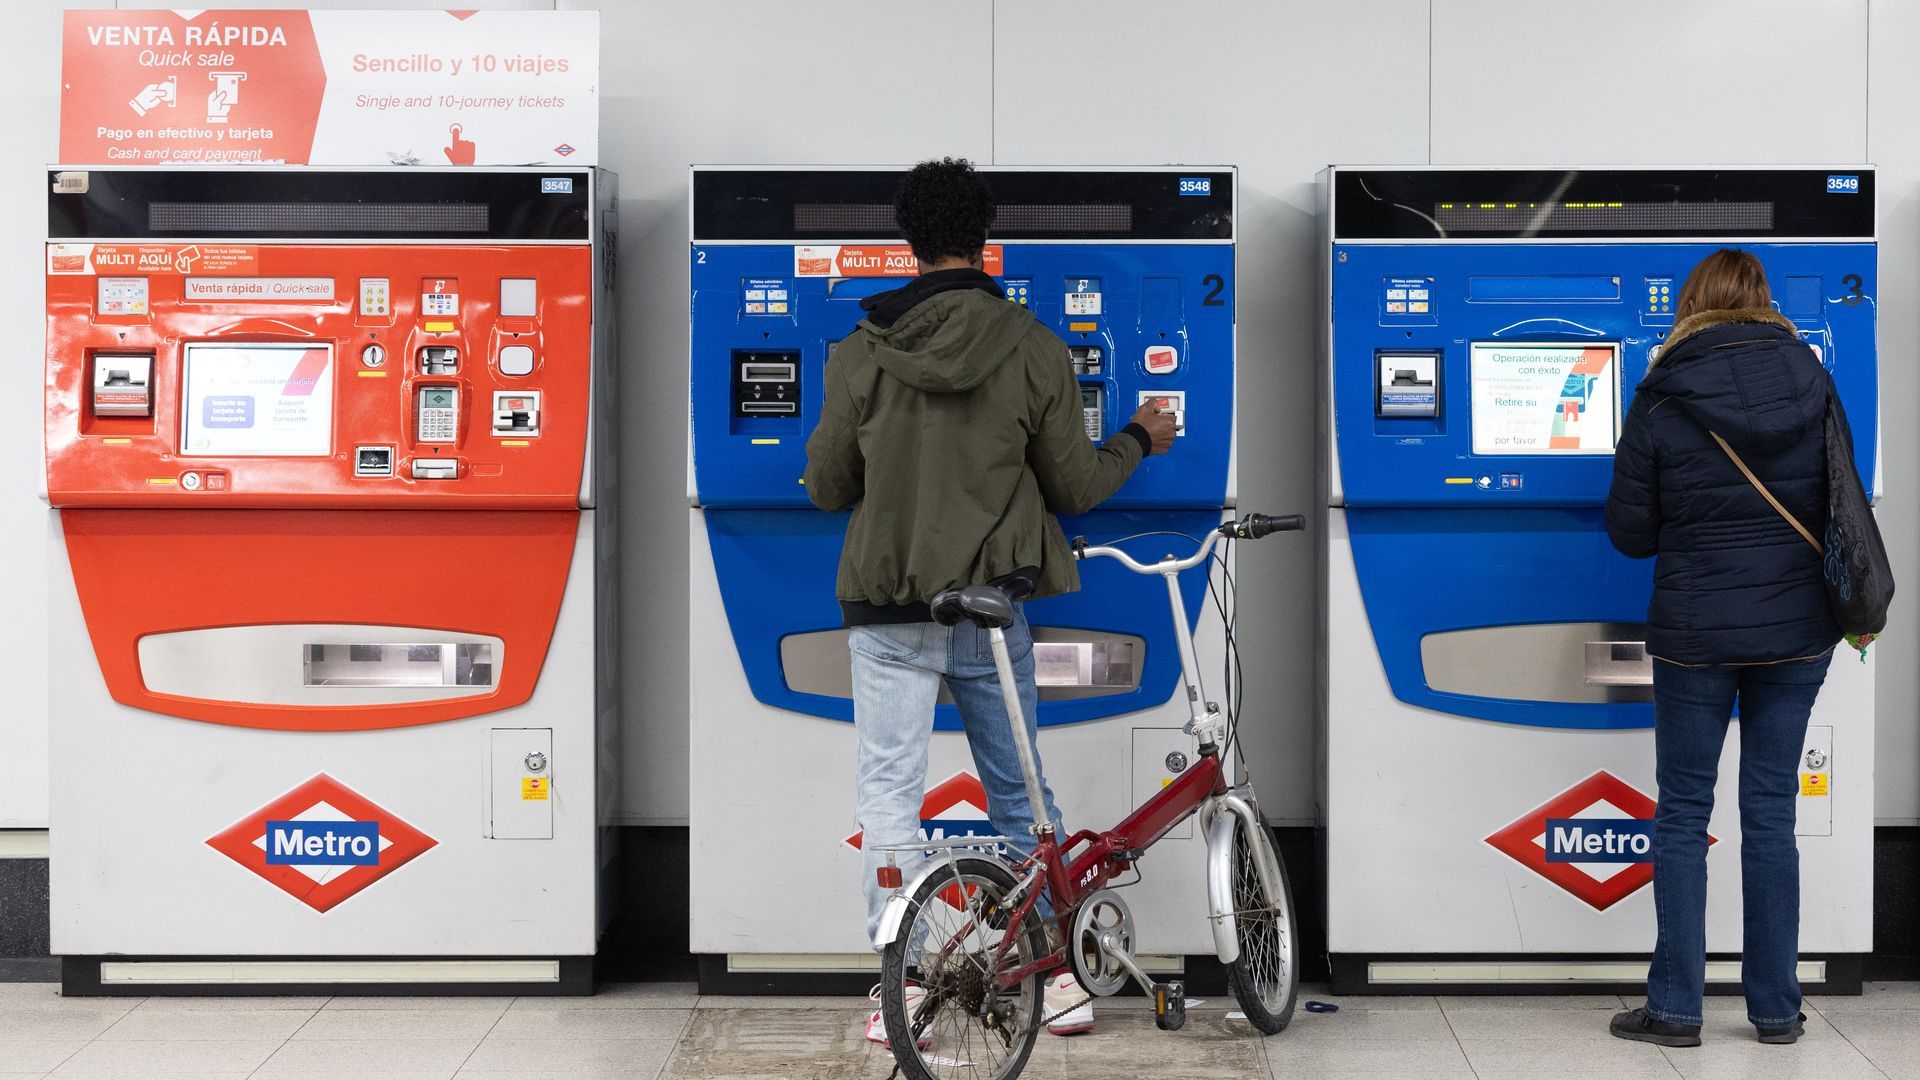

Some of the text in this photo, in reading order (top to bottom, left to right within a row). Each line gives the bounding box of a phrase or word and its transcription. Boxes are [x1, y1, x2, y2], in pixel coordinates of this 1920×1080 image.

[87, 22, 287, 46] VENTA RÁPIDA
[138, 49, 235, 67] Quick sale
[352, 54, 569, 76] Sencillo y 10 viajes
[355, 95, 565, 111] Single and 10-journey tickets
[97, 126, 273, 142] Pago en efectivo y tarjeta
[107, 146, 262, 161] Cash and card payment
[544, 181, 570, 191] 3547
[1179, 181, 1210, 192] 3548
[1827, 178, 1859, 190] 3549
[97, 247, 166, 255] Tarjeta Disponible
[697, 251, 706, 264] 2
[96, 252, 172, 265] MULTI AQUÍ
[842, 257, 880, 268] MULTI
[191, 283, 223, 293] Venta
[226, 282, 263, 296] rápida
[273, 282, 306, 294] Quick
[307, 283, 330, 294] sale
[1202, 273, 1225, 307] 2
[1841, 273, 1864, 307] 3
[1492, 353, 1587, 364] Operación realizada
[1518, 365, 1561, 375] con éxito
[277, 399, 305, 407] Adquirir
[1494, 397, 1537, 407] Retire su
[212, 407, 235, 415] tarjeta
[210, 415, 247, 424] transporte
[273, 415, 308, 423] transporte
[1494, 436, 1537, 446] por favor
[274, 828, 372, 857] Metro
[1553, 826, 1650, 855] Metro
[1086, 863, 1098, 882] 8.0
